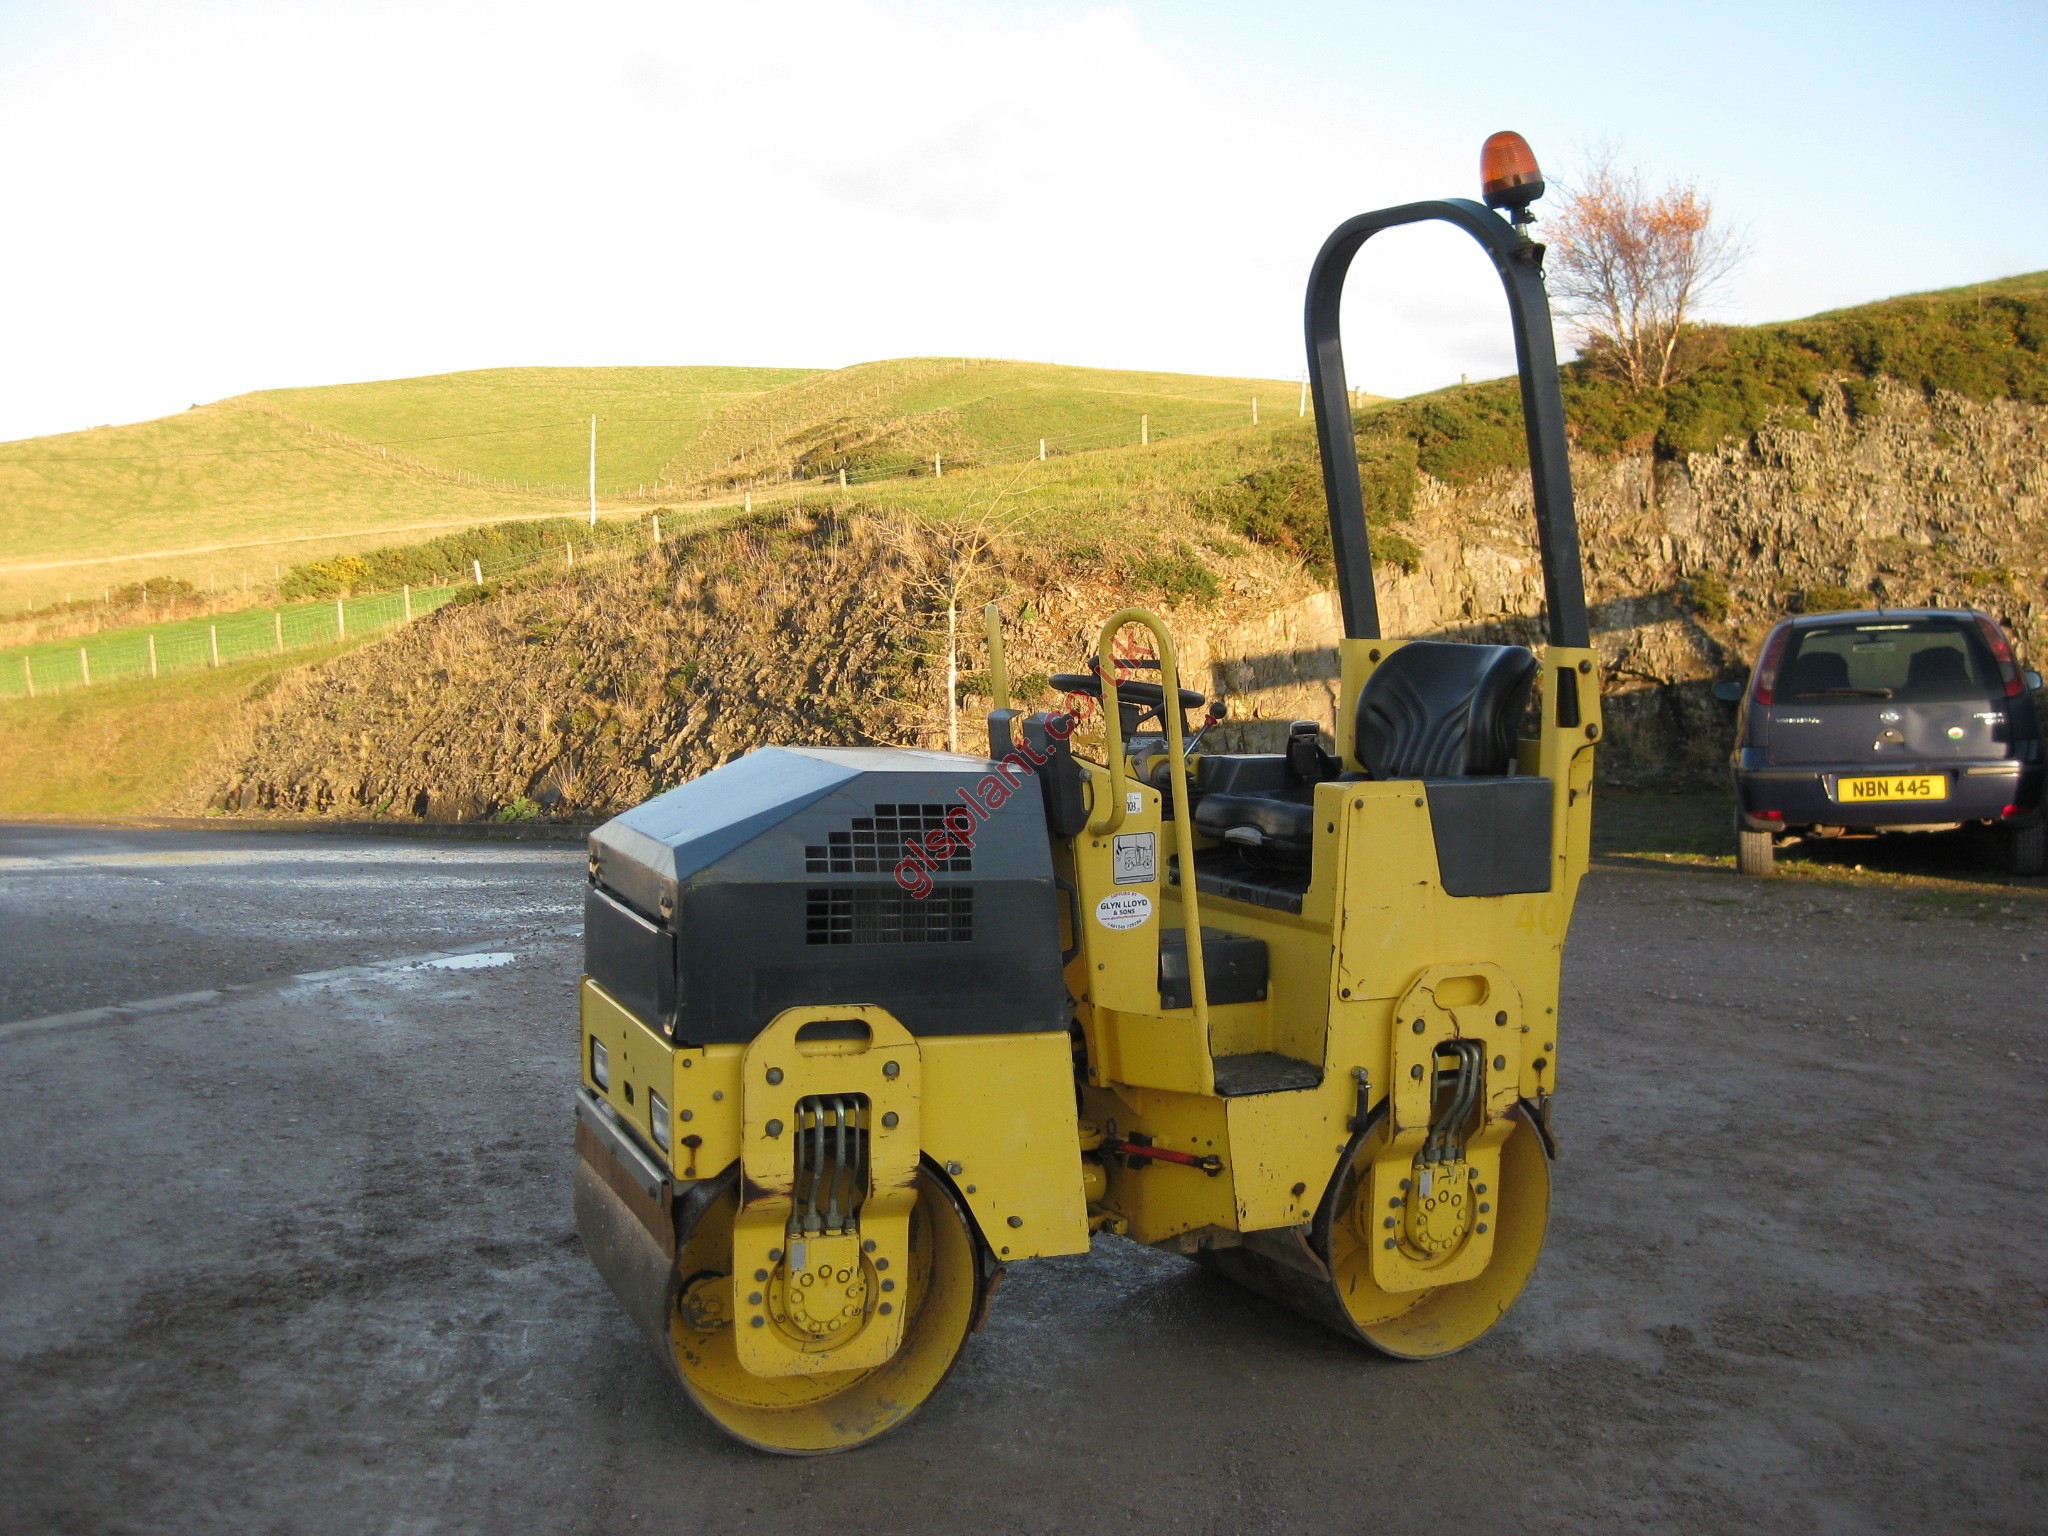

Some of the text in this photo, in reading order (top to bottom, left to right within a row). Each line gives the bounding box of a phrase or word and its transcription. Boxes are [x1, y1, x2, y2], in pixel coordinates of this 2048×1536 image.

[1853, 779, 1930, 798] NBN 445
[1100, 899, 1148, 910] GLYN LLOYD
